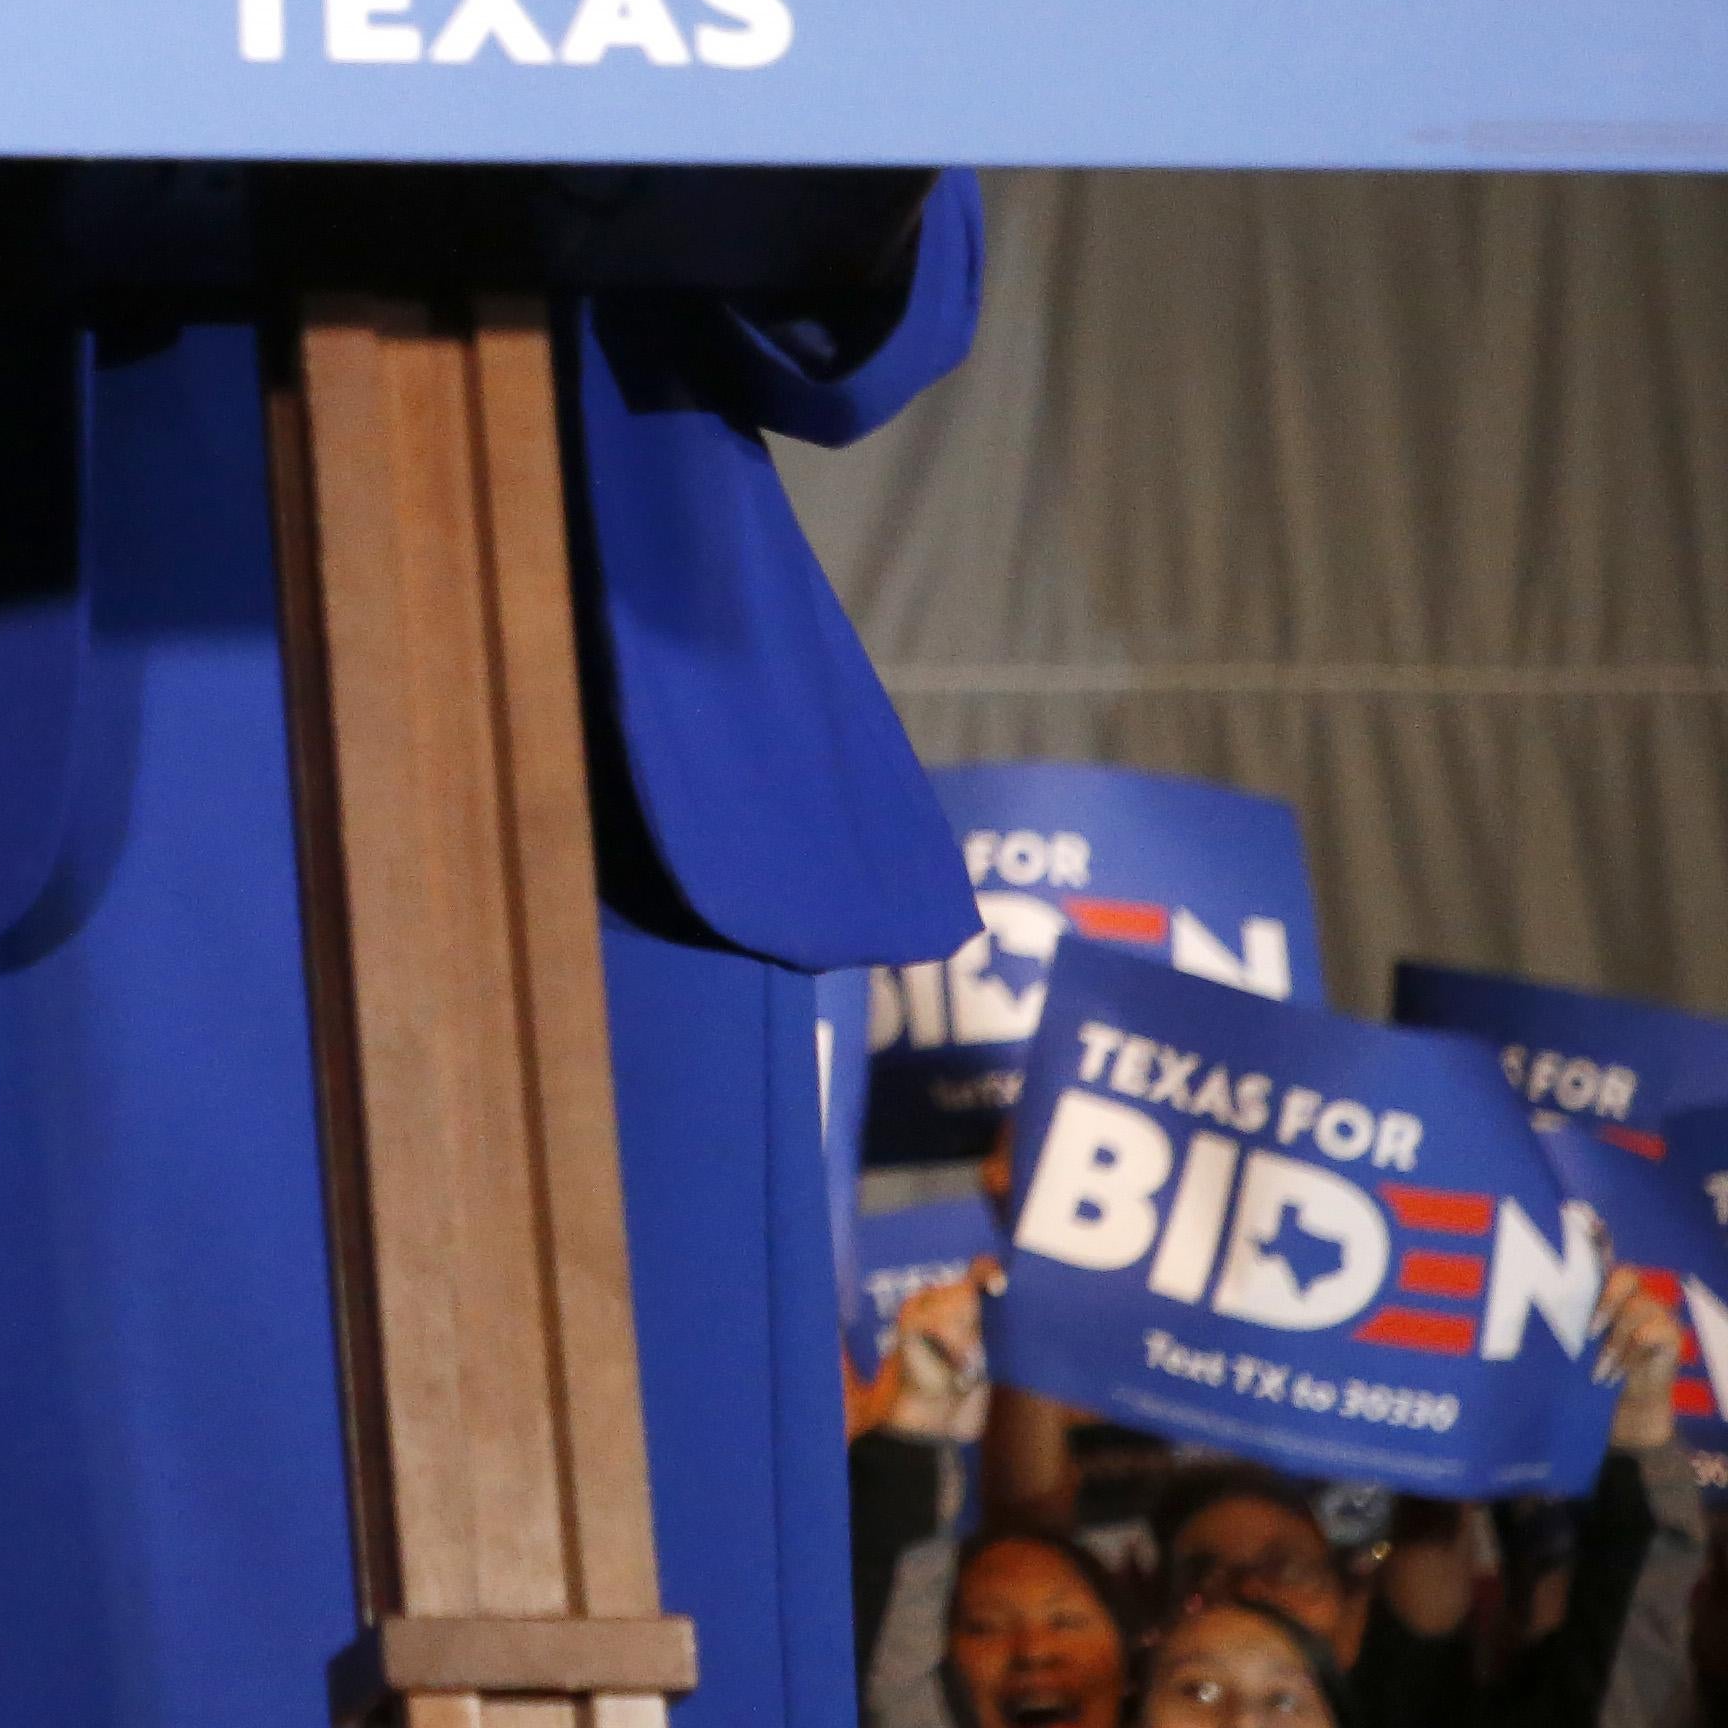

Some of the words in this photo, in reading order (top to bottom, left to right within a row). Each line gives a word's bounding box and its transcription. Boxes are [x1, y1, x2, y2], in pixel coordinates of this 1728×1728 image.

[962, 828, 1093, 889] FOR
[1078, 1020, 1273, 1135] TEXAS
[1275, 1085, 1423, 1172] FOR
[1527, 1049, 1639, 1121] FOR
[1014, 1087, 1605, 1362] BIDEN
